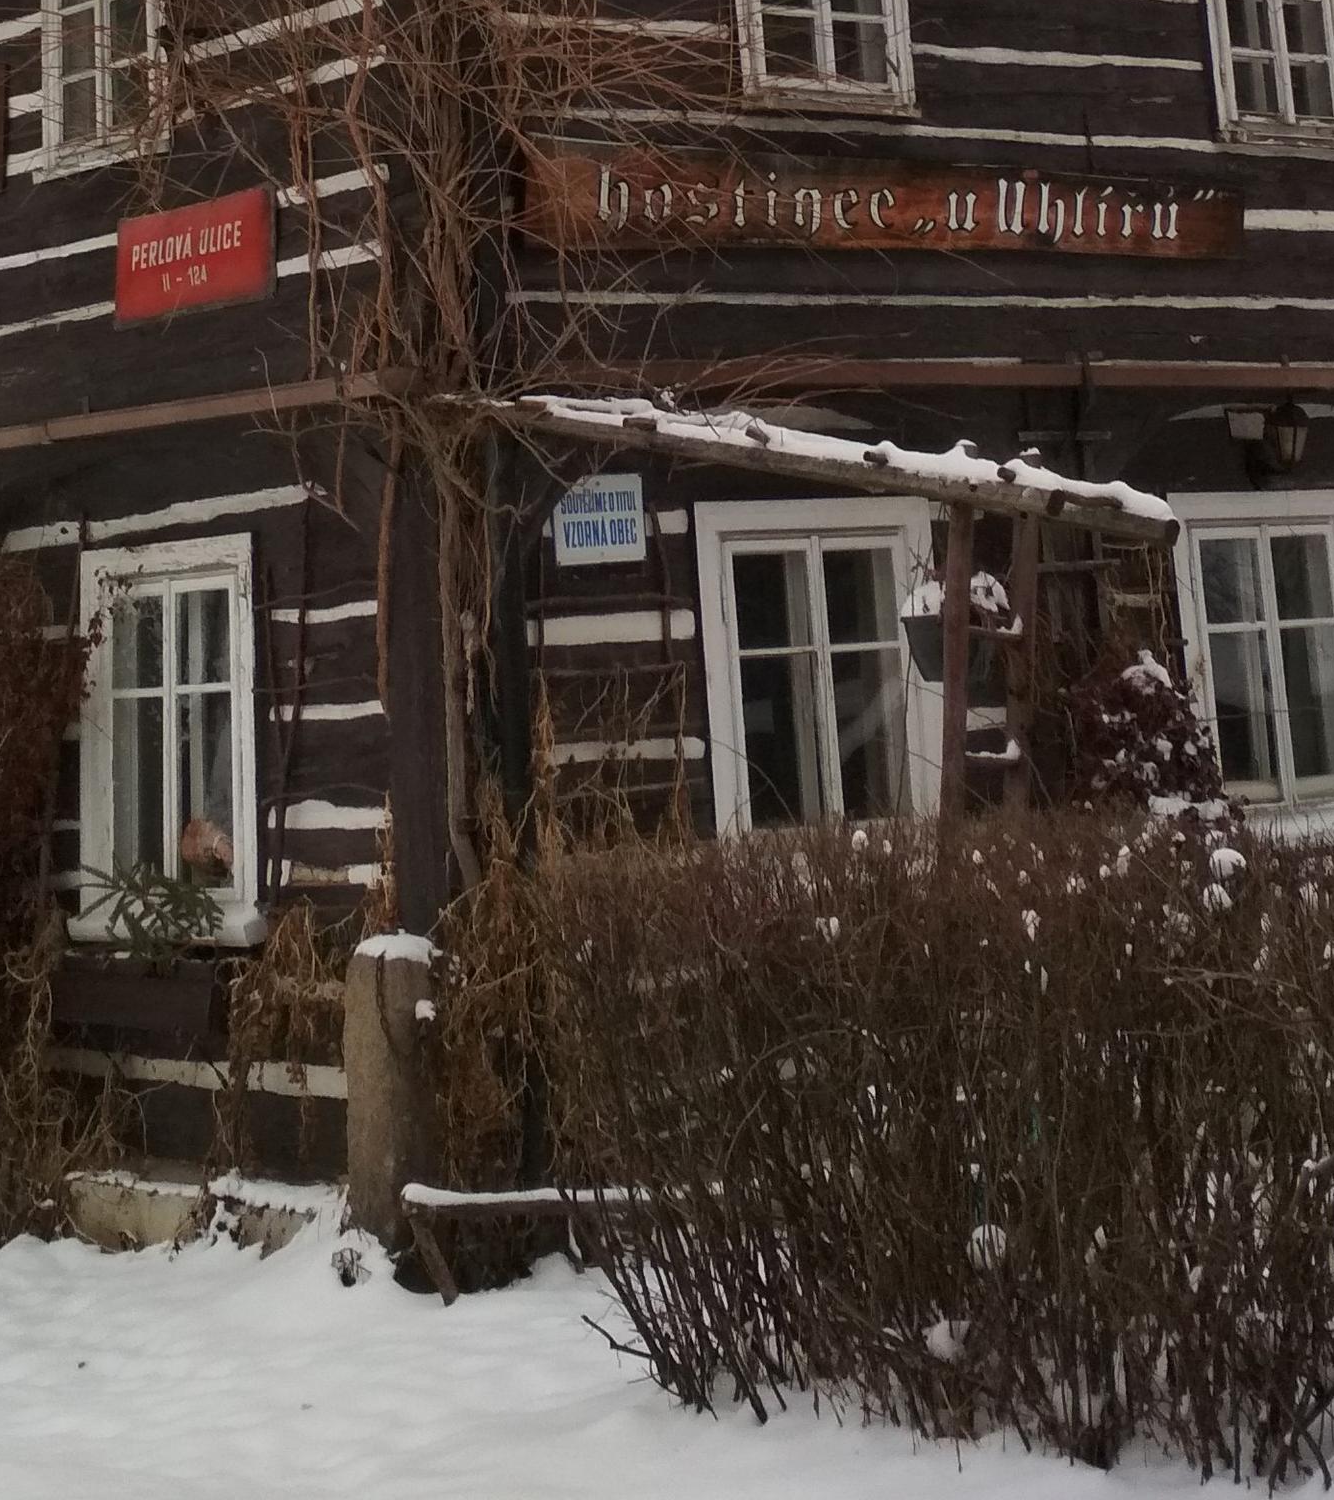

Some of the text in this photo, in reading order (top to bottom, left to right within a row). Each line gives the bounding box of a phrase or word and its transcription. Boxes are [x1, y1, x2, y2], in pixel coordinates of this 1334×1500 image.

[131, 220, 242, 272] PERLOVÁ ULICE
[187, 264, 208, 287] 124
[609, 491, 616, 513] O
[616, 490, 637, 512] TITUL
[563, 516, 638, 549] VZORNÁ OBEC
